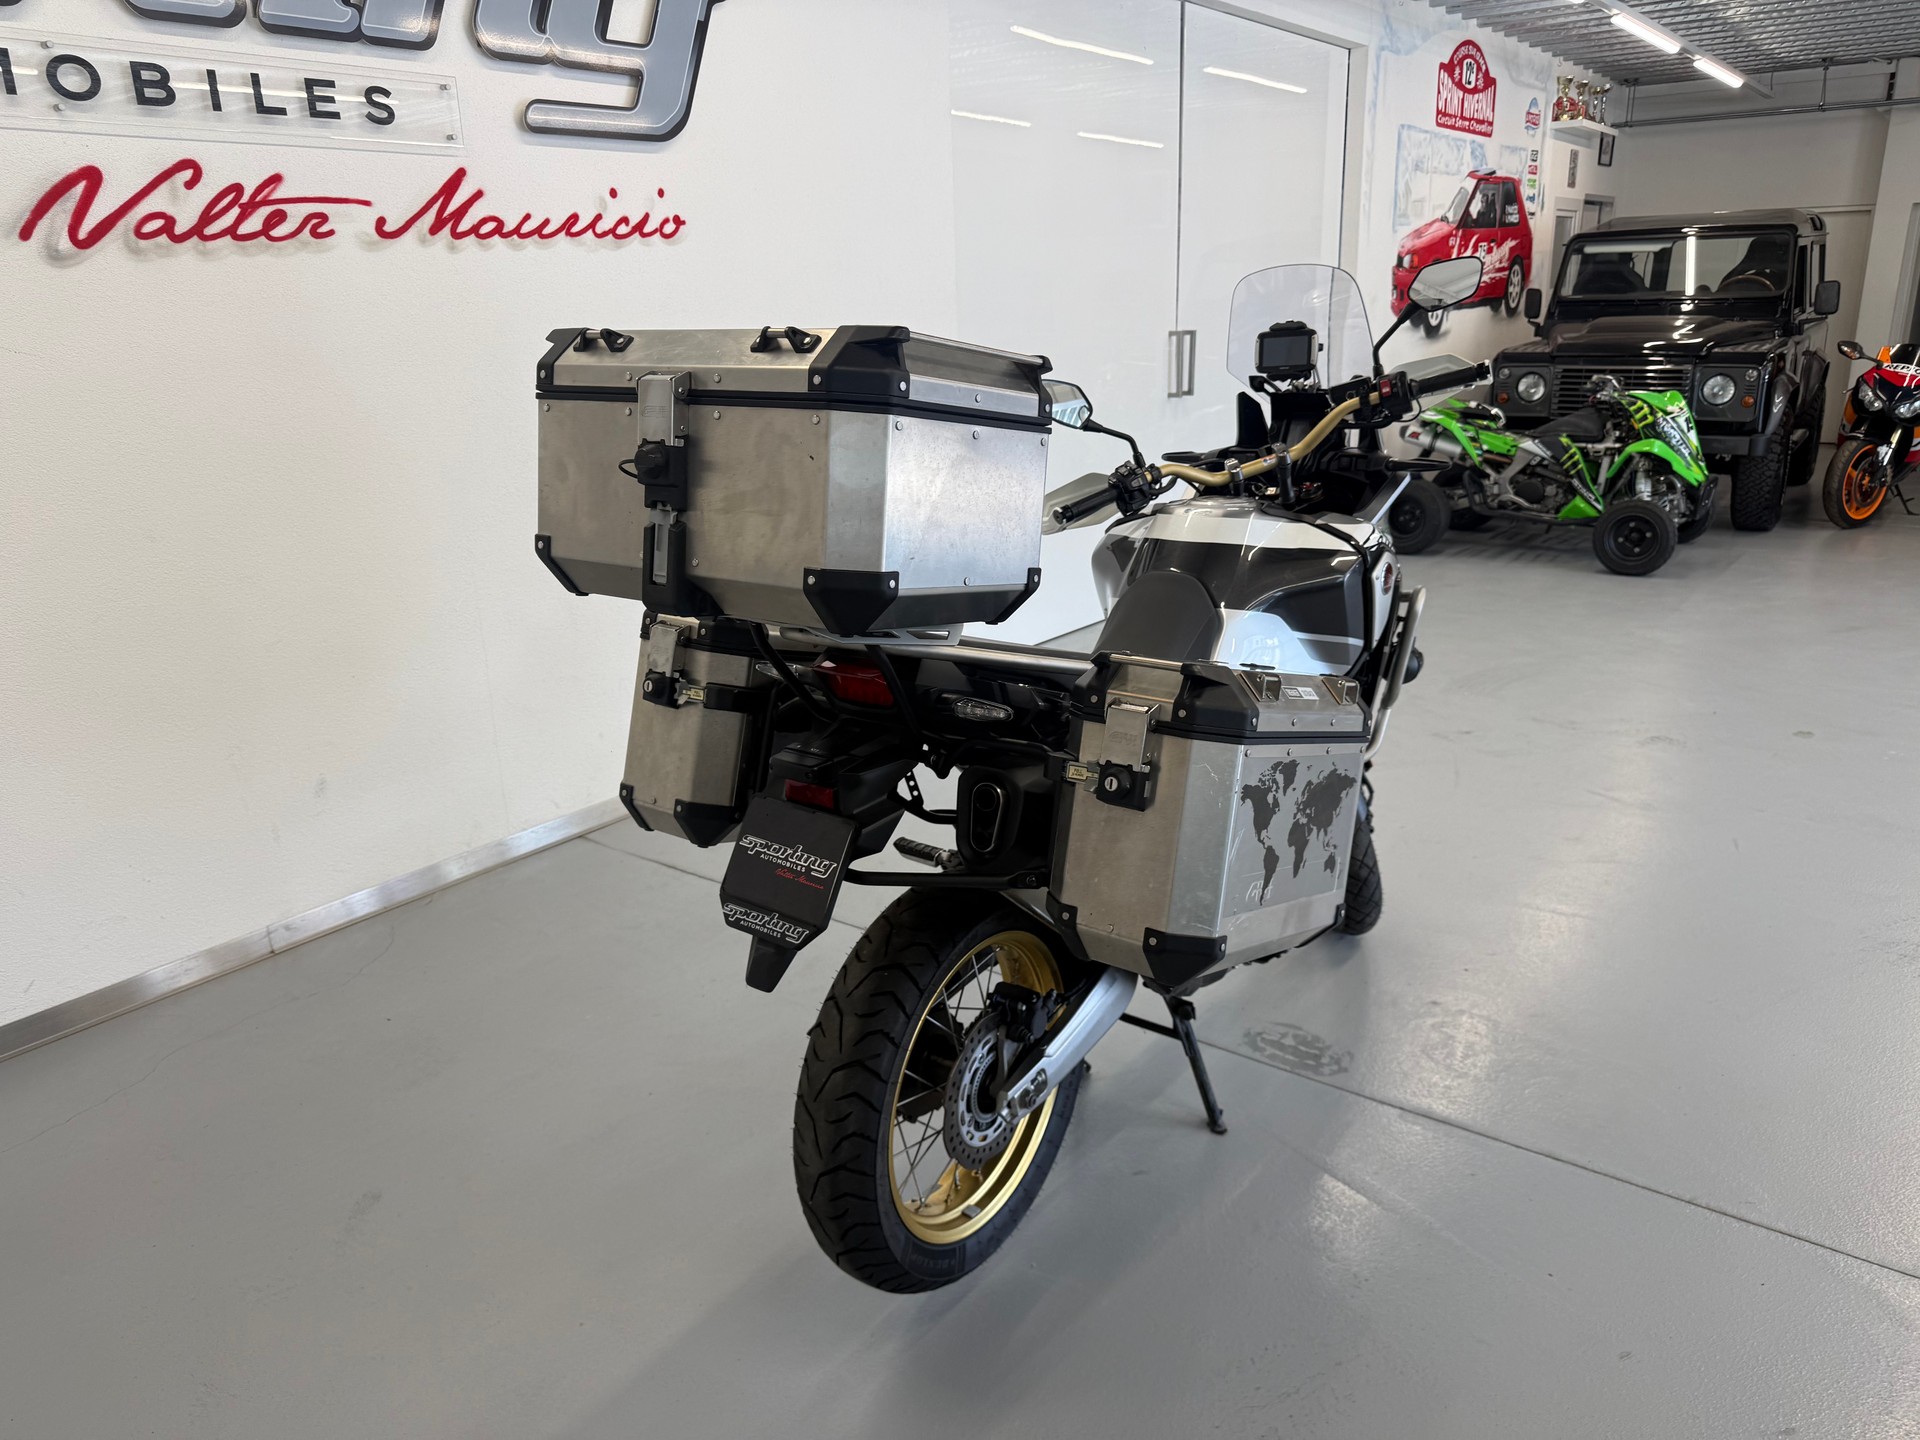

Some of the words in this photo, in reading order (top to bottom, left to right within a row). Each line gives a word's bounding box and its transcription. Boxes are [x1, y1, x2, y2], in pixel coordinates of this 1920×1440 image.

[1438, 69, 1463, 116] SPRINT
[1463, 84, 1494, 122] HIVERNAL
[19, 158, 372, 250] Valter
[375, 167, 686, 242] Mauricio
[760, 853, 806, 873] AUTOMOBILES
[740, 920, 781, 938] AUTOMOBILES
